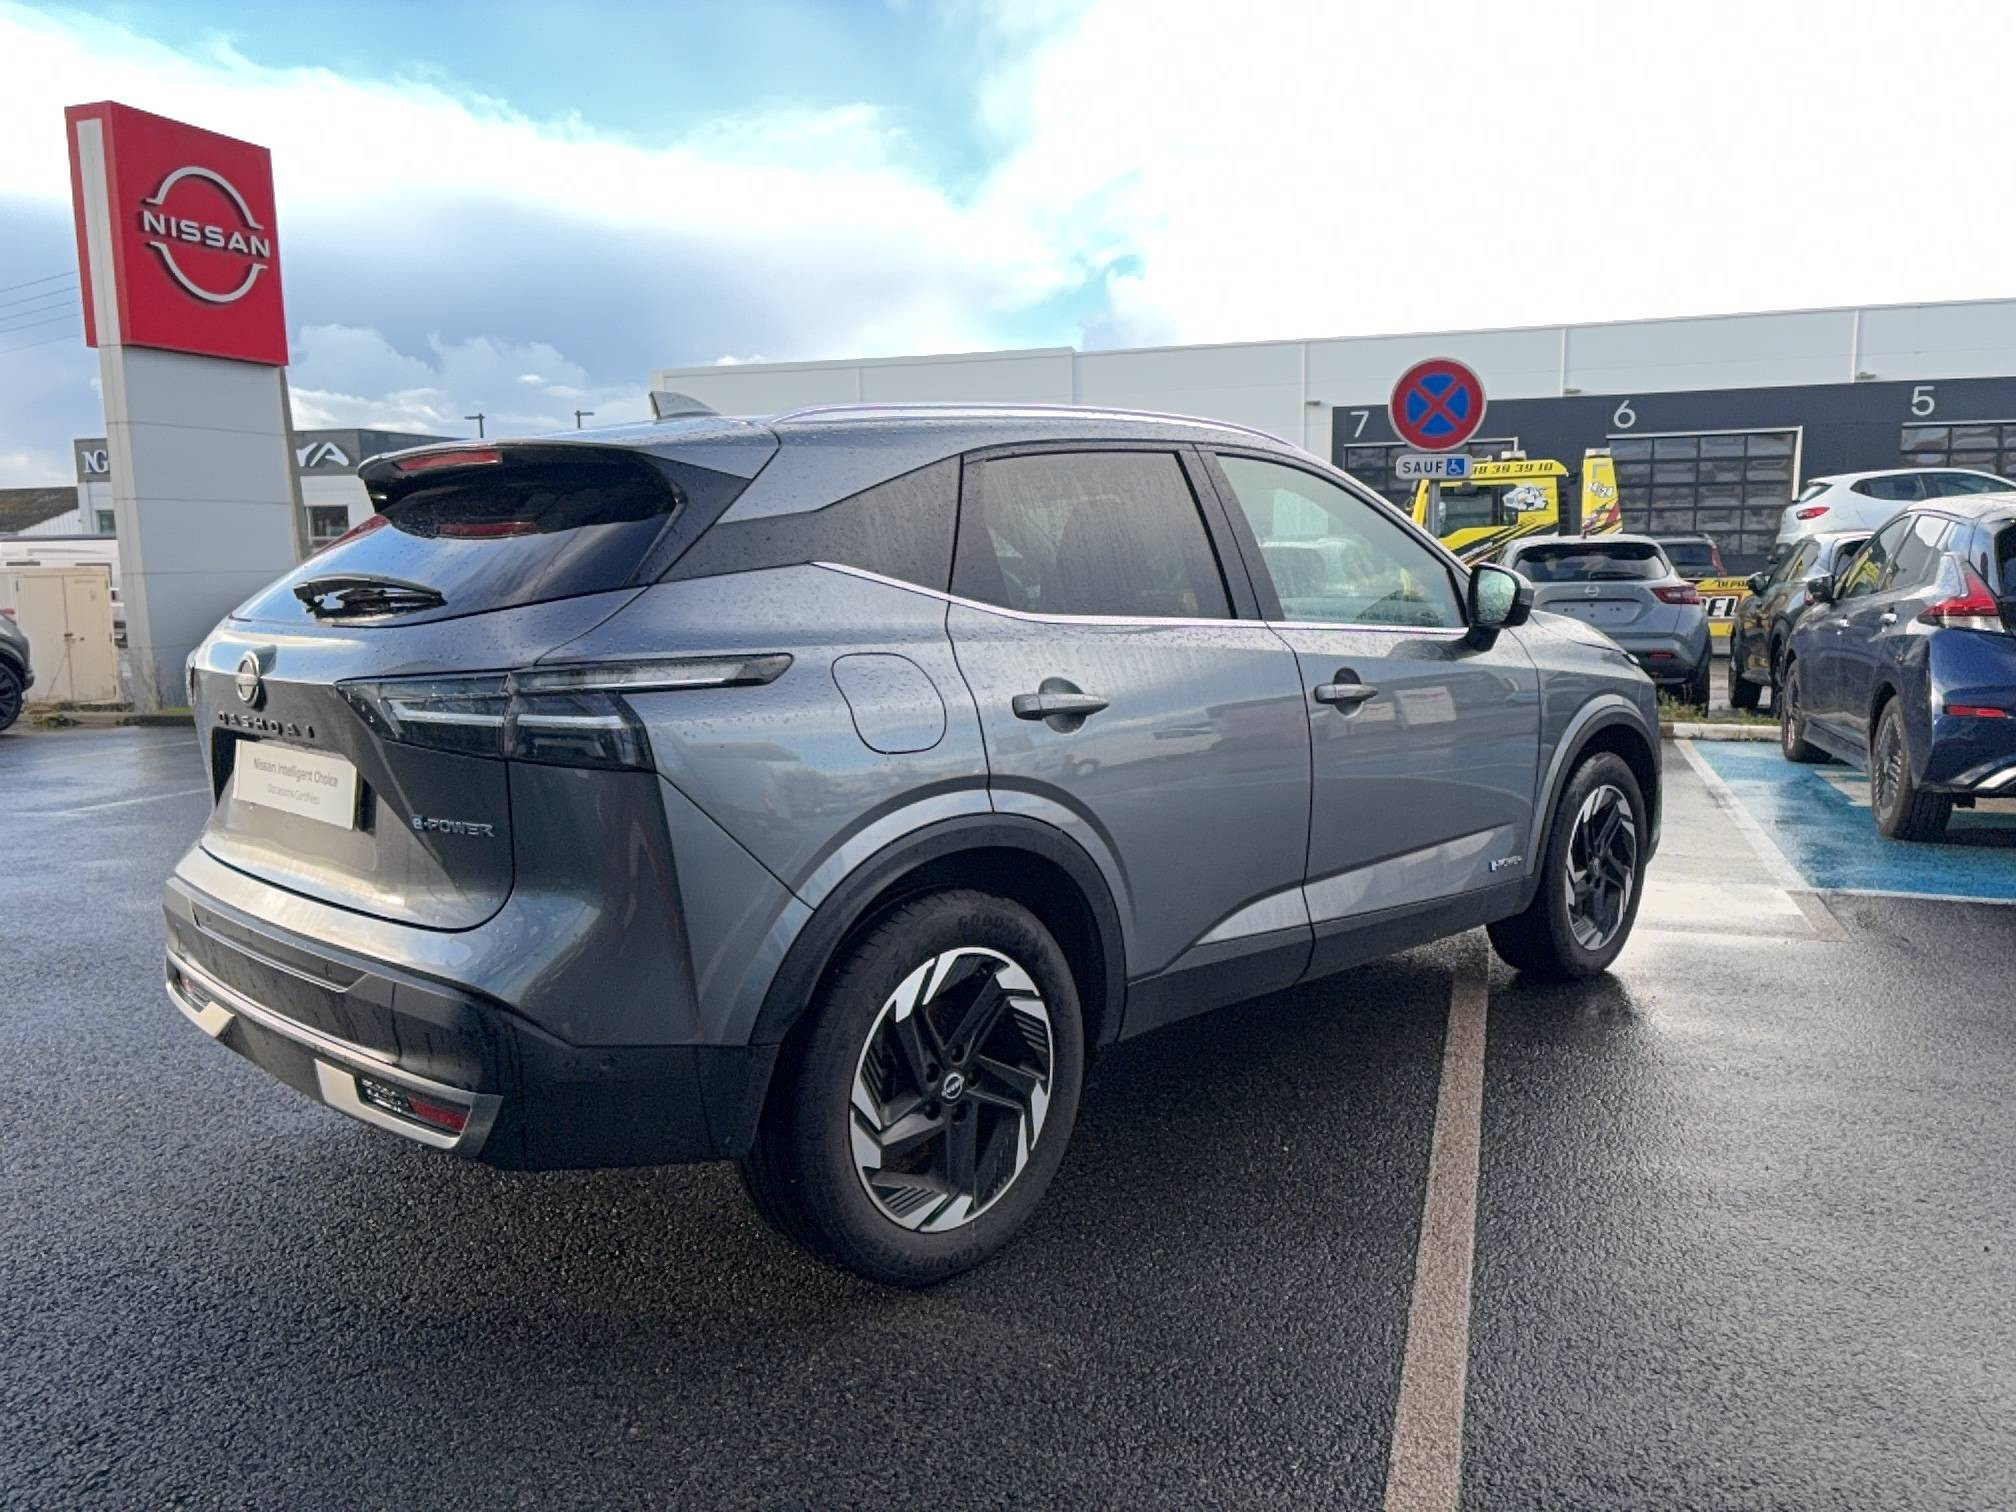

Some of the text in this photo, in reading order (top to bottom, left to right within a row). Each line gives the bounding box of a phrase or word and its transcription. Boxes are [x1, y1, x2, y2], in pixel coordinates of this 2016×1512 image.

[143, 210, 271, 258] NISSAN
[1613, 399, 1636, 429] 6
[1911, 385, 1935, 416] 5
[1350, 411, 1369, 438] 7
[1402, 461, 1444, 474] SAUF
[253, 757, 339, 788] Nissan Intelligent Choice
